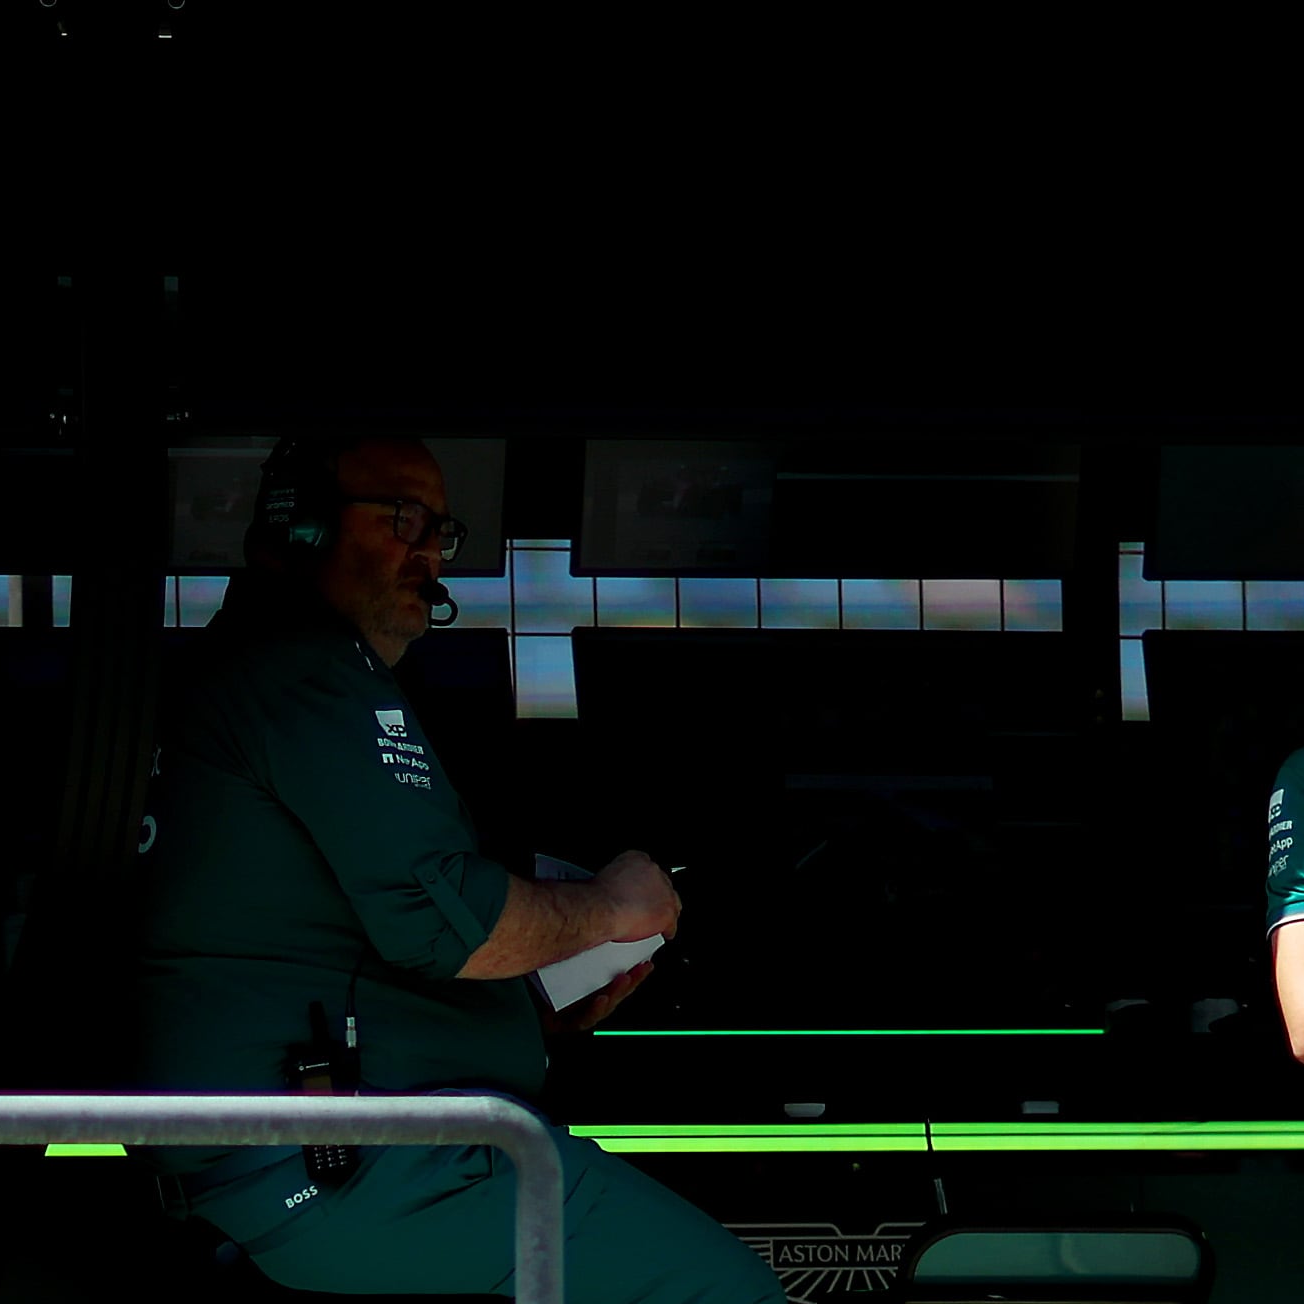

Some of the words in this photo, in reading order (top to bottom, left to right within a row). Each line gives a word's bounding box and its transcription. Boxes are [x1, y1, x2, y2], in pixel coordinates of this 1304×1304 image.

[285, 1185, 319, 1208] BOSS
[778, 1243, 850, 1264] ASTON
[855, 1243, 905, 1263] MAR
